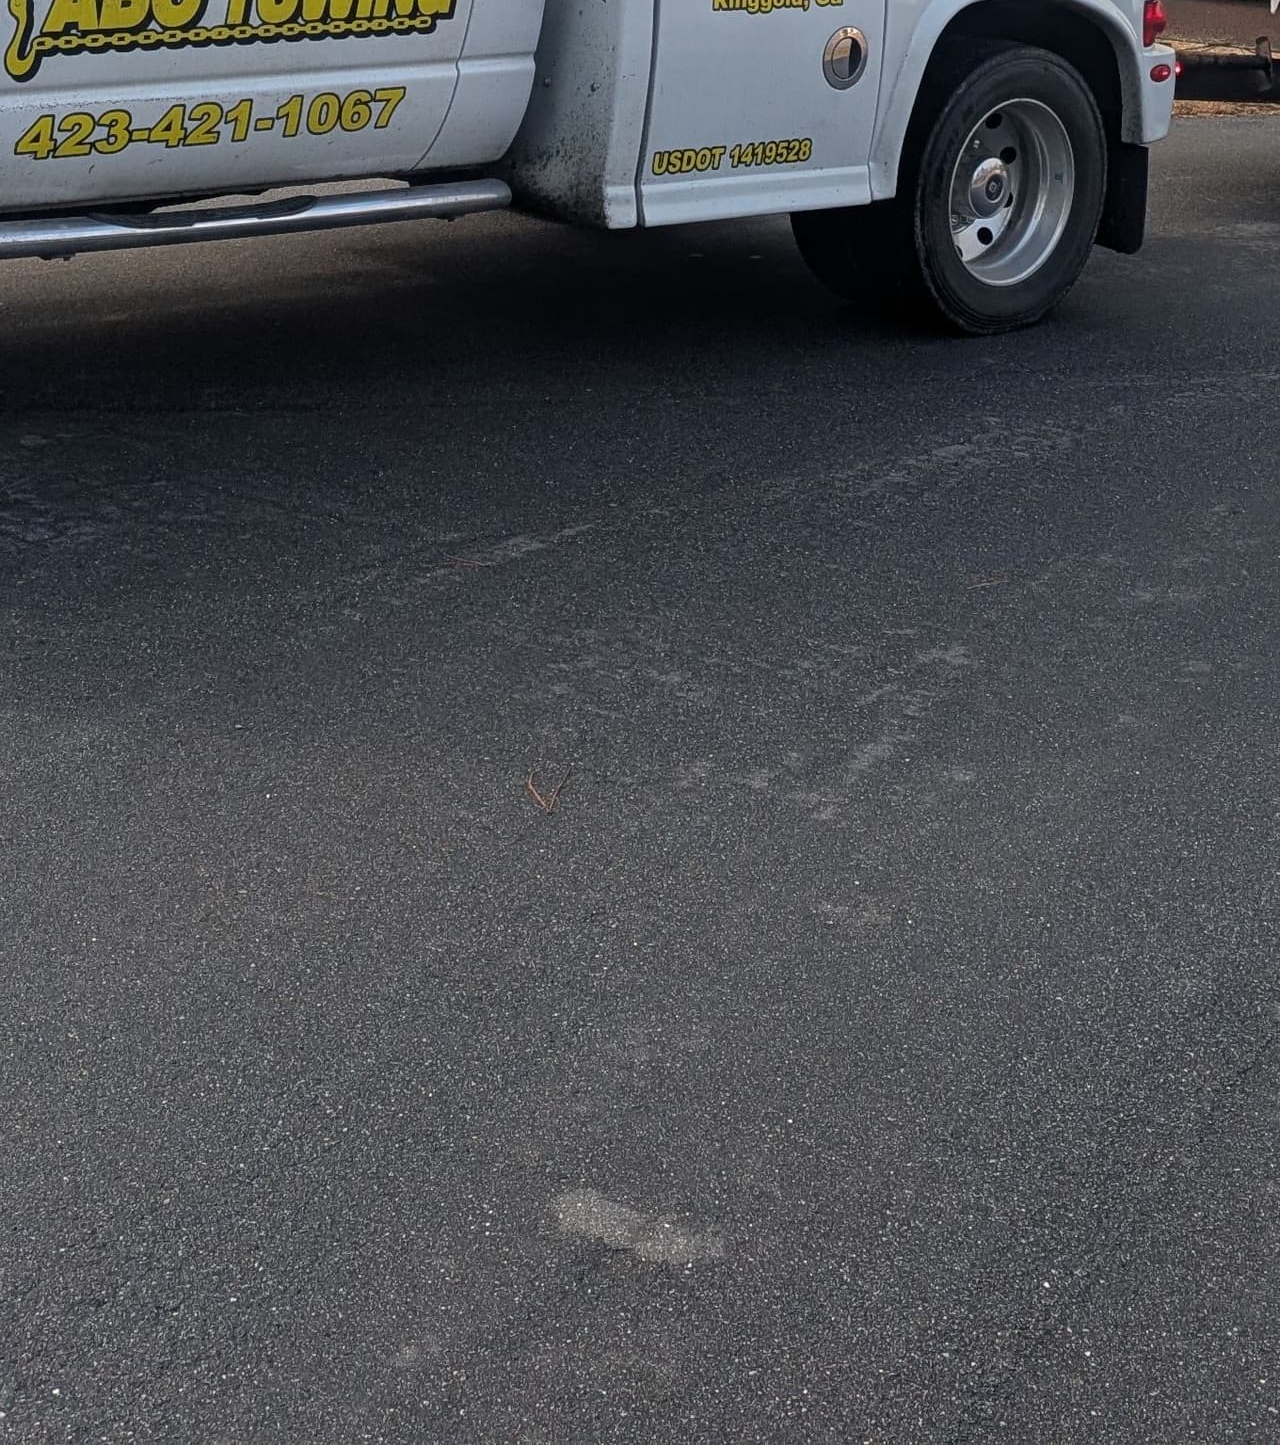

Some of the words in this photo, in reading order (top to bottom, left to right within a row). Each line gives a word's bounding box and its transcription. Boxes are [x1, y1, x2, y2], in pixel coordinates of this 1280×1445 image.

[14, 86, 407, 160] 423-421-1067
[651, 145, 725, 176] USDOT
[729, 137, 813, 168] 1419528
